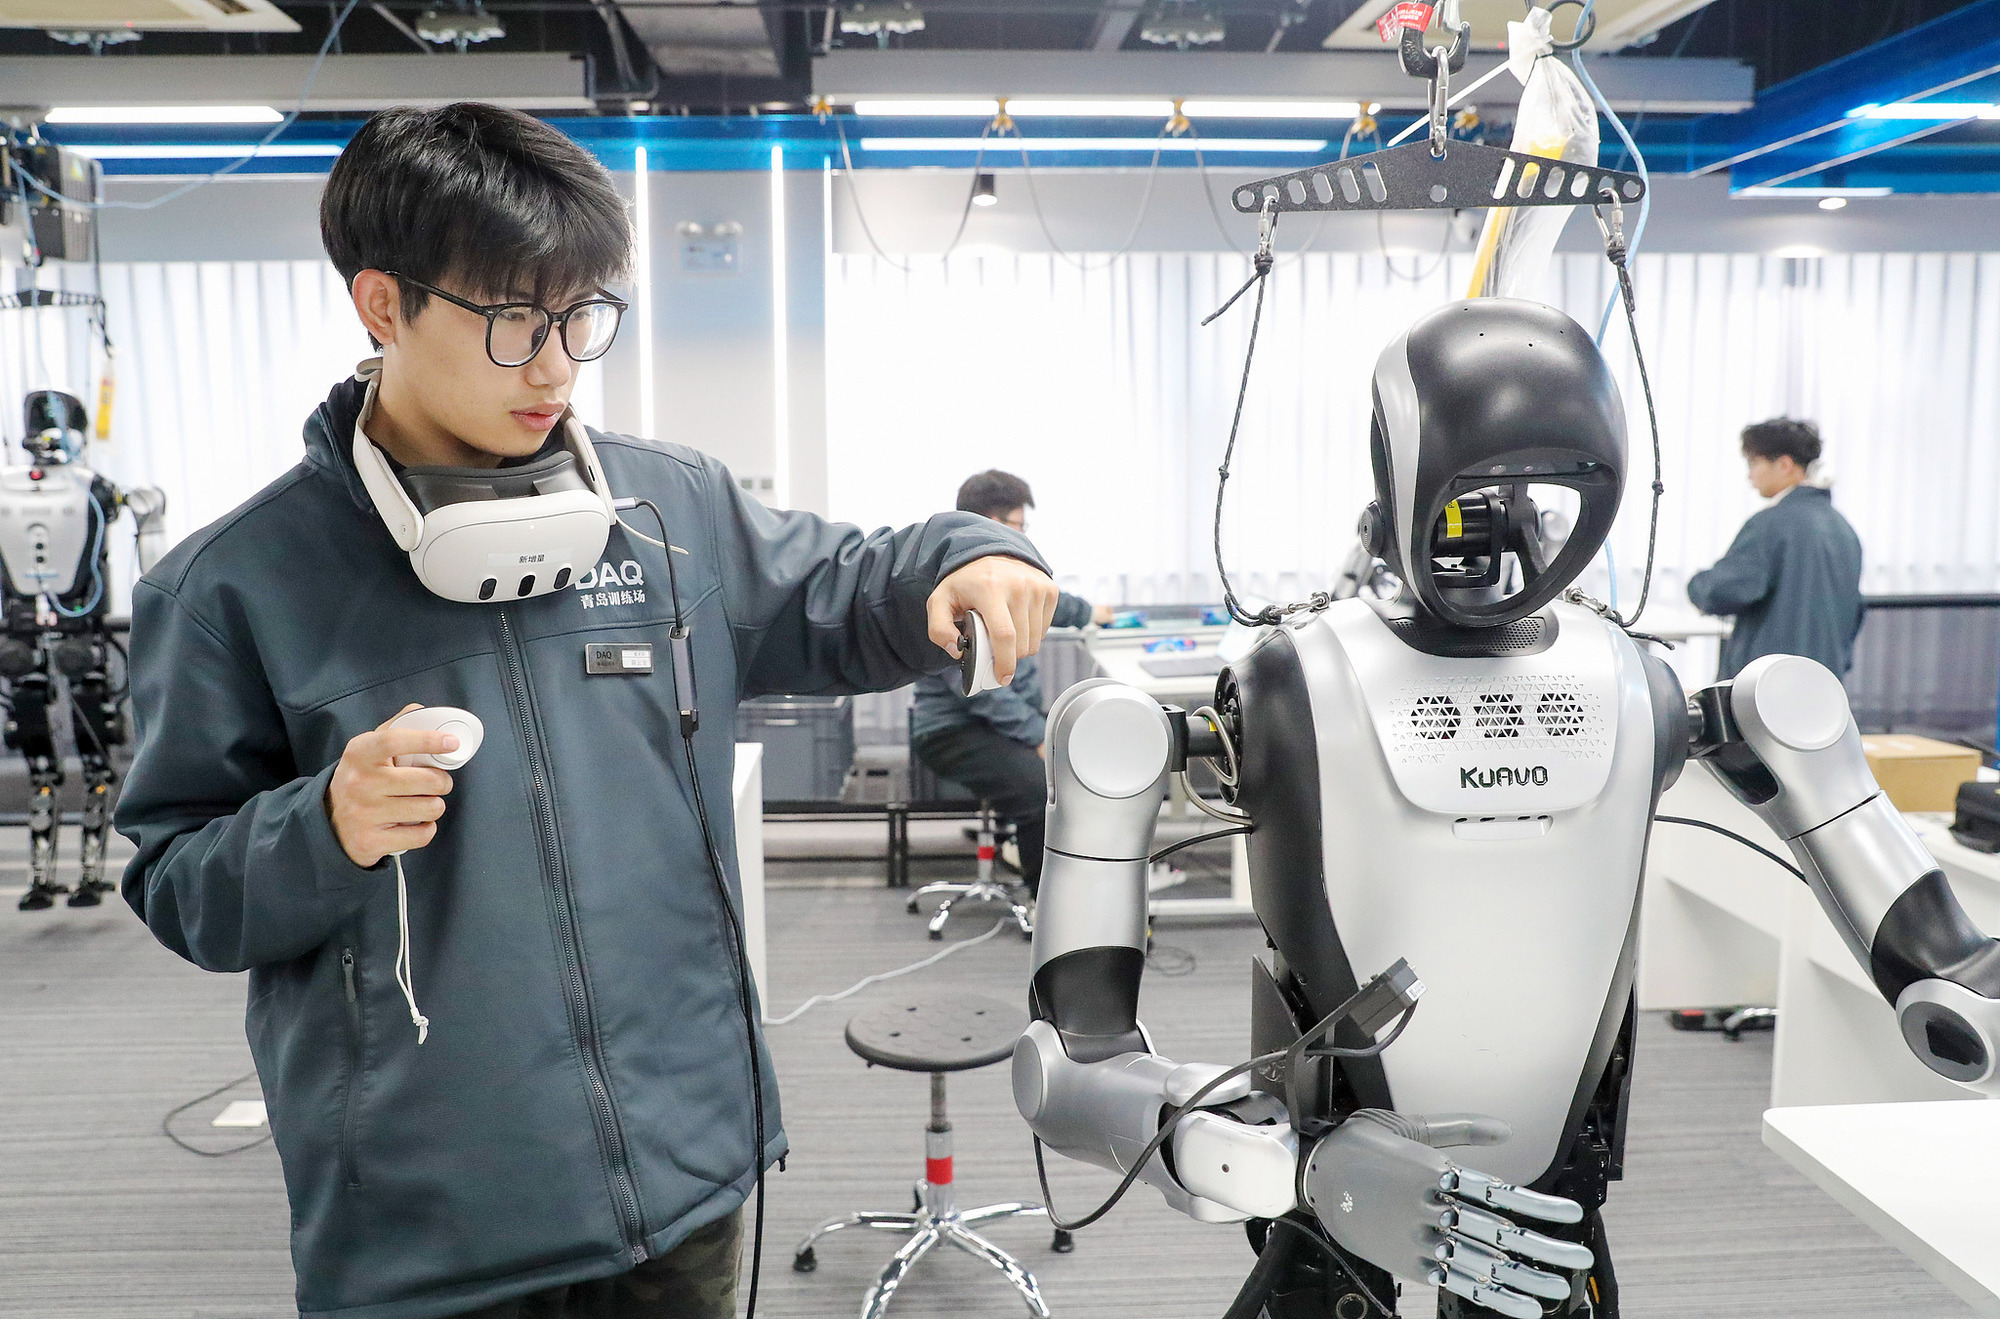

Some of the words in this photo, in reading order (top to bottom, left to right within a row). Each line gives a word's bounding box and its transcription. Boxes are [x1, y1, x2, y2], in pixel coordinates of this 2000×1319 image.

[580, 589, 646, 609] 青岛训练场
[596, 651, 612, 660] DAQ
[1460, 766, 1548, 789] KUAVO
